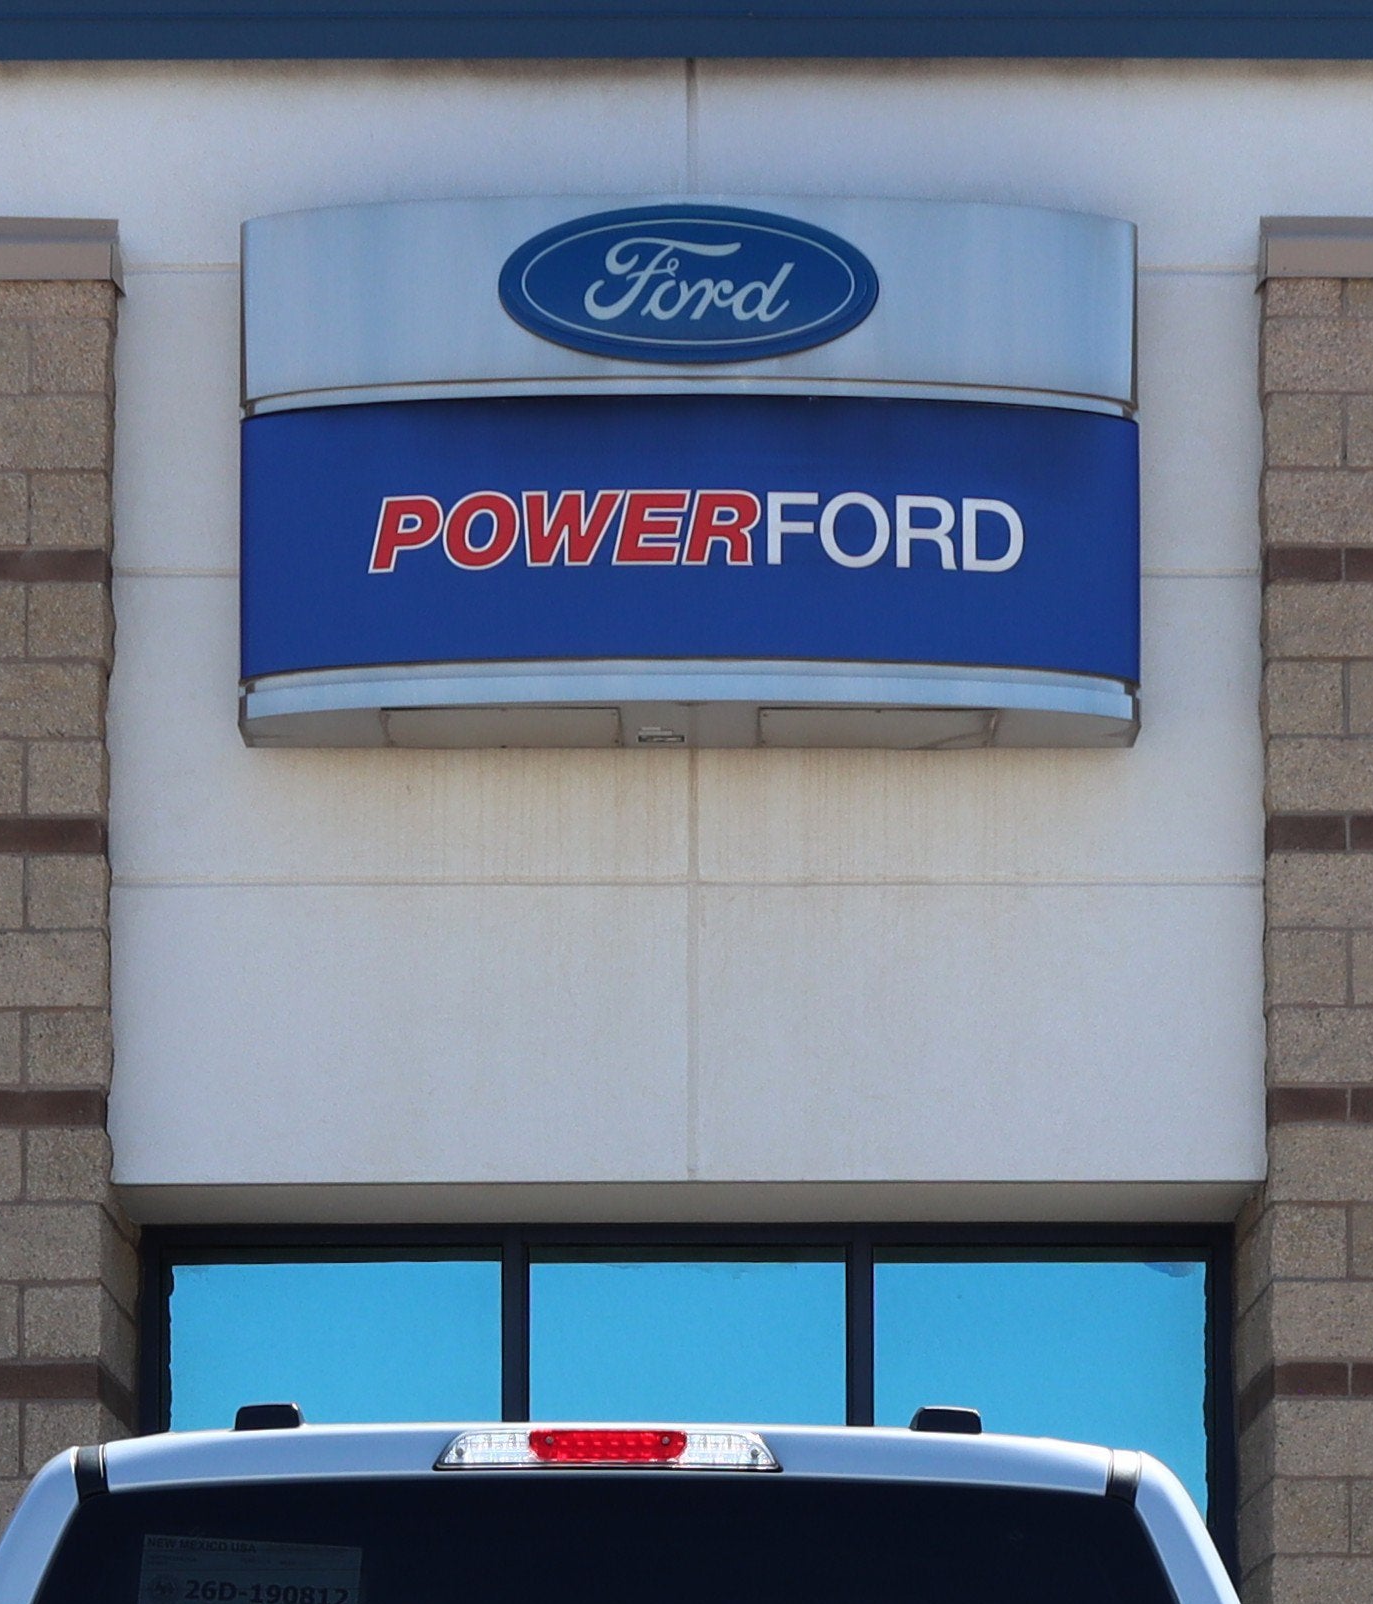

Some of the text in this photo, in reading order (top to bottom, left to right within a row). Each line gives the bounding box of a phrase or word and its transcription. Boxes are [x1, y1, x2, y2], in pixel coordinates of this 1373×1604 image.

[582, 236, 795, 323] Ford
[367, 488, 1026, 575] POWERFORD
[146, 1538, 258, 1554] NEW MEXICO USA
